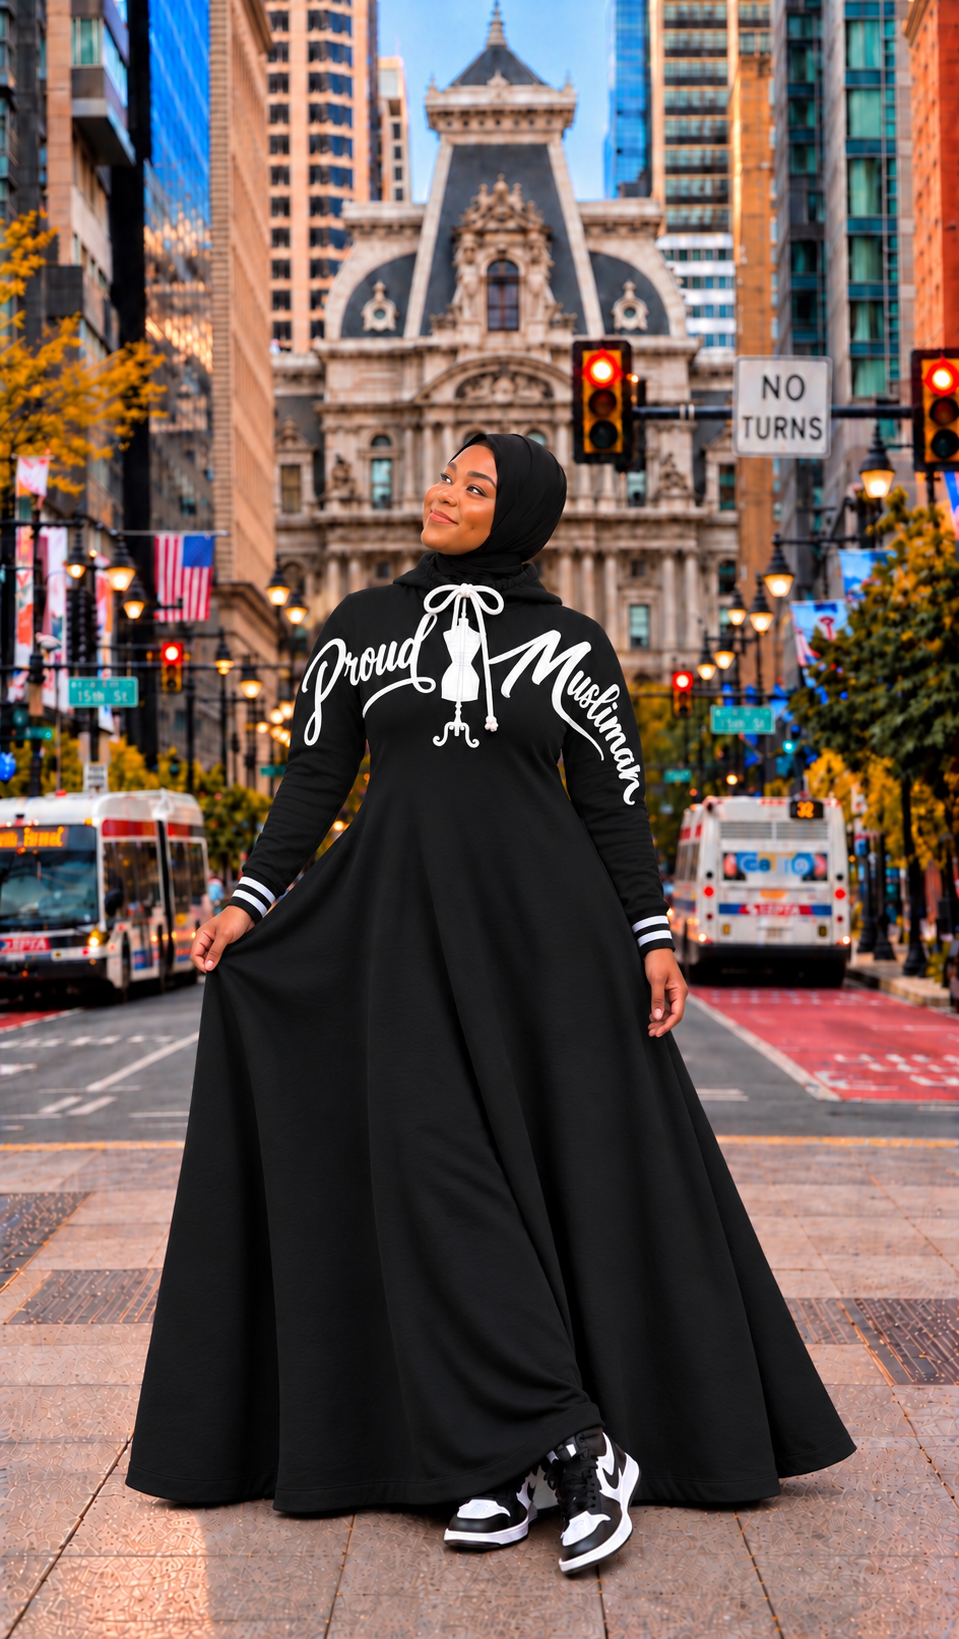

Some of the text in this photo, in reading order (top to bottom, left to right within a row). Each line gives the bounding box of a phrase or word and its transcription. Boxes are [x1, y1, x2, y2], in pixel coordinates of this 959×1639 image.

[762, 374, 806, 401] NO
[741, 416, 823, 441] TURNS
[301, 613, 437, 747] Proud
[78, 690, 128, 703] 15th St
[796, 800, 815, 819] 32
